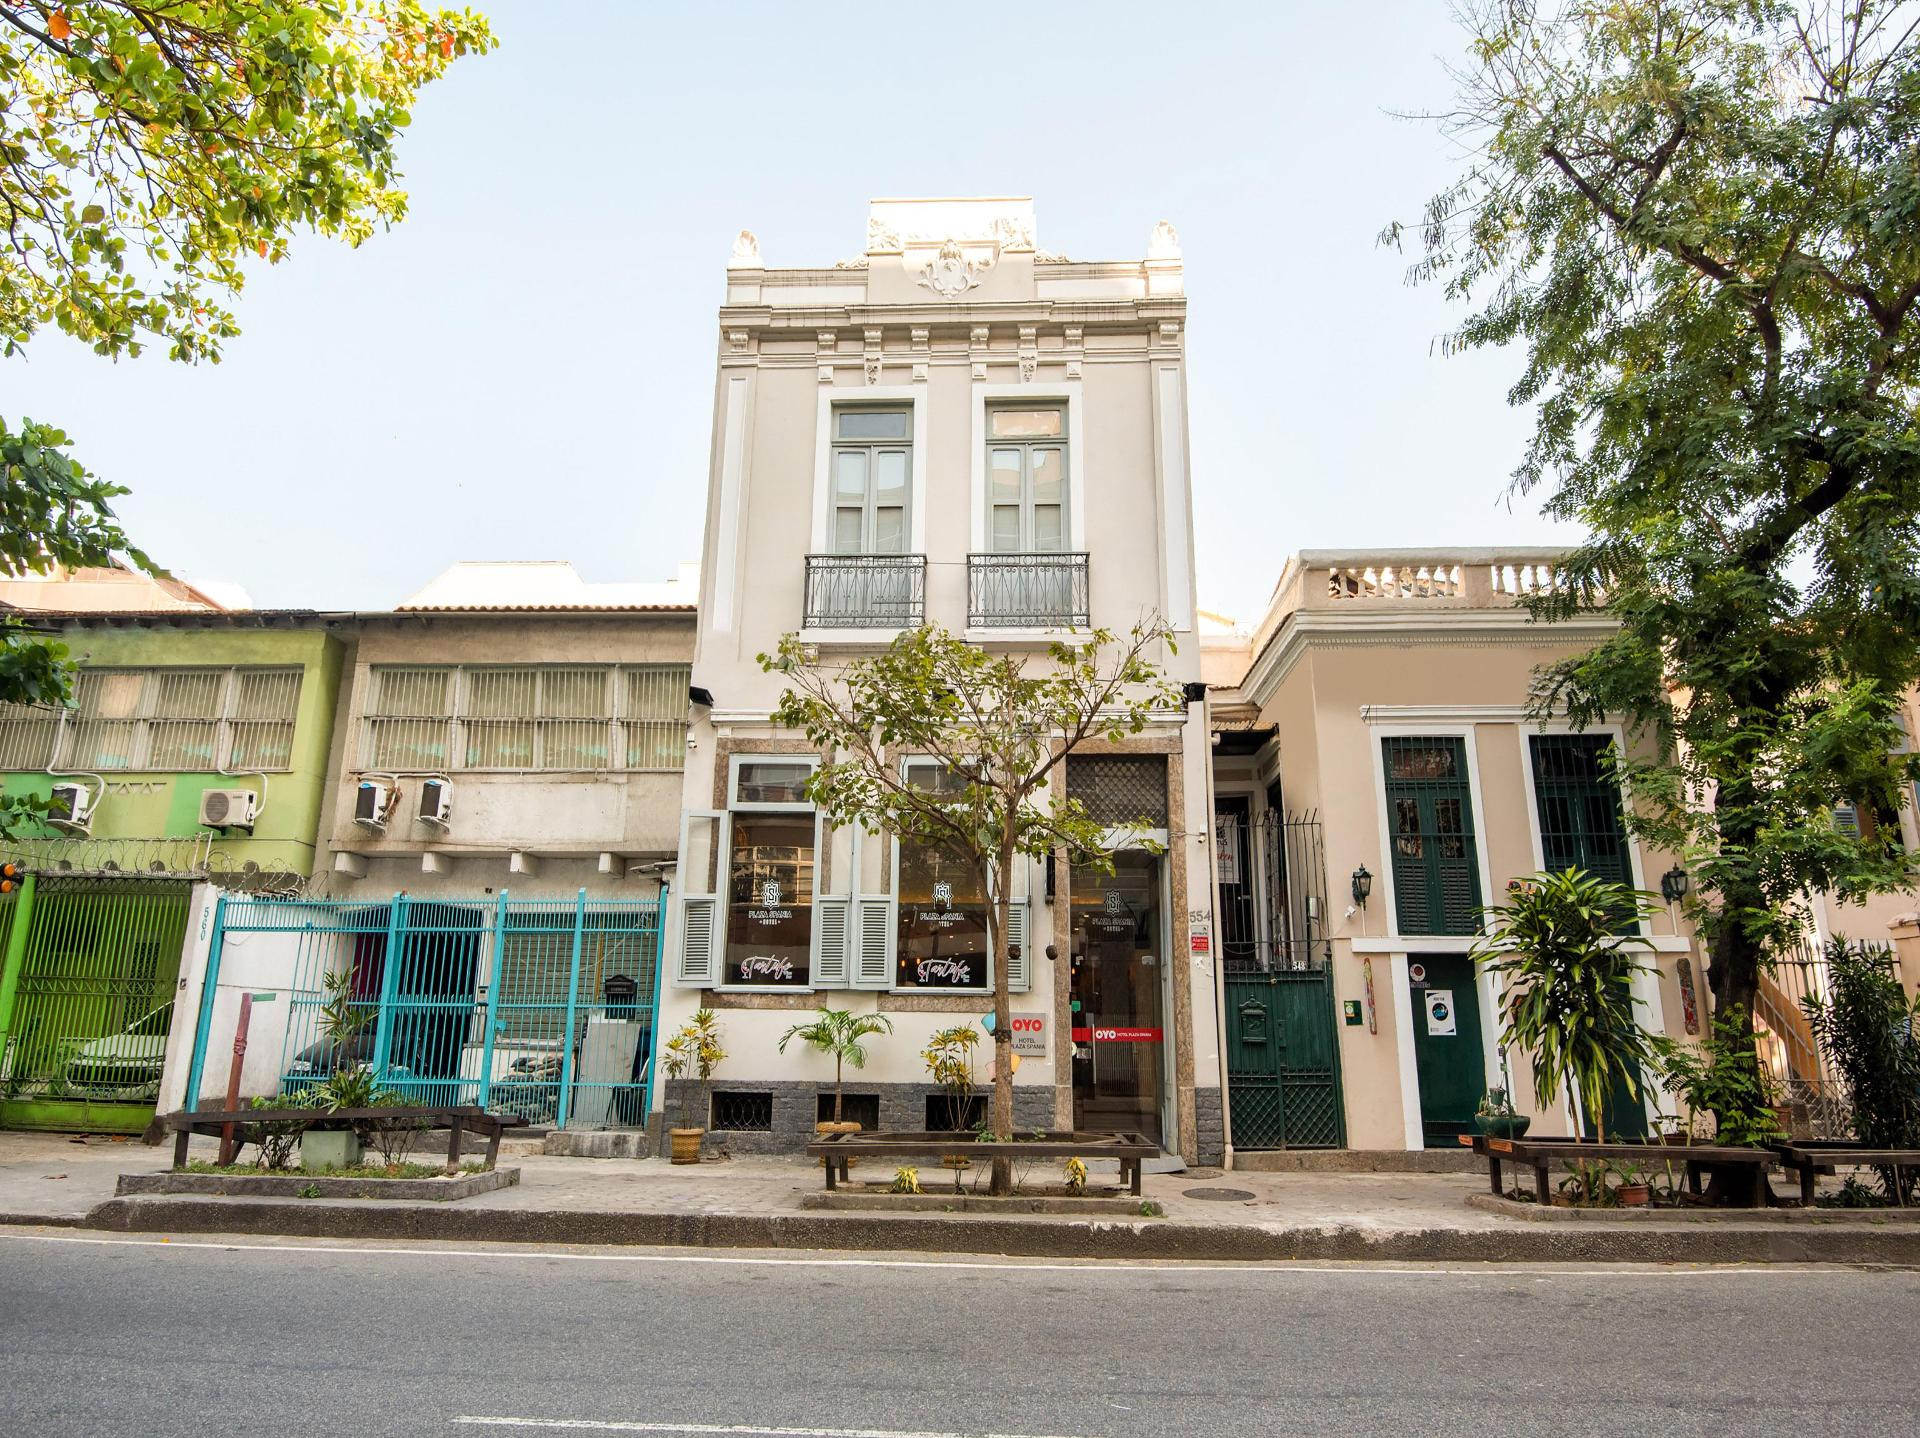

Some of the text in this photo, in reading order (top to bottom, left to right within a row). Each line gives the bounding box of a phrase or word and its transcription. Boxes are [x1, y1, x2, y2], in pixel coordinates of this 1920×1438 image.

[748, 910, 793, 919] PLAZA SPANIA
[920, 912, 941, 921] PLAZA
[1189, 909, 1211, 923] 554
[200, 906, 210, 941] 560
[1012, 1018, 1043, 1032] OYO
[1095, 1030, 1117, 1039] OYO
